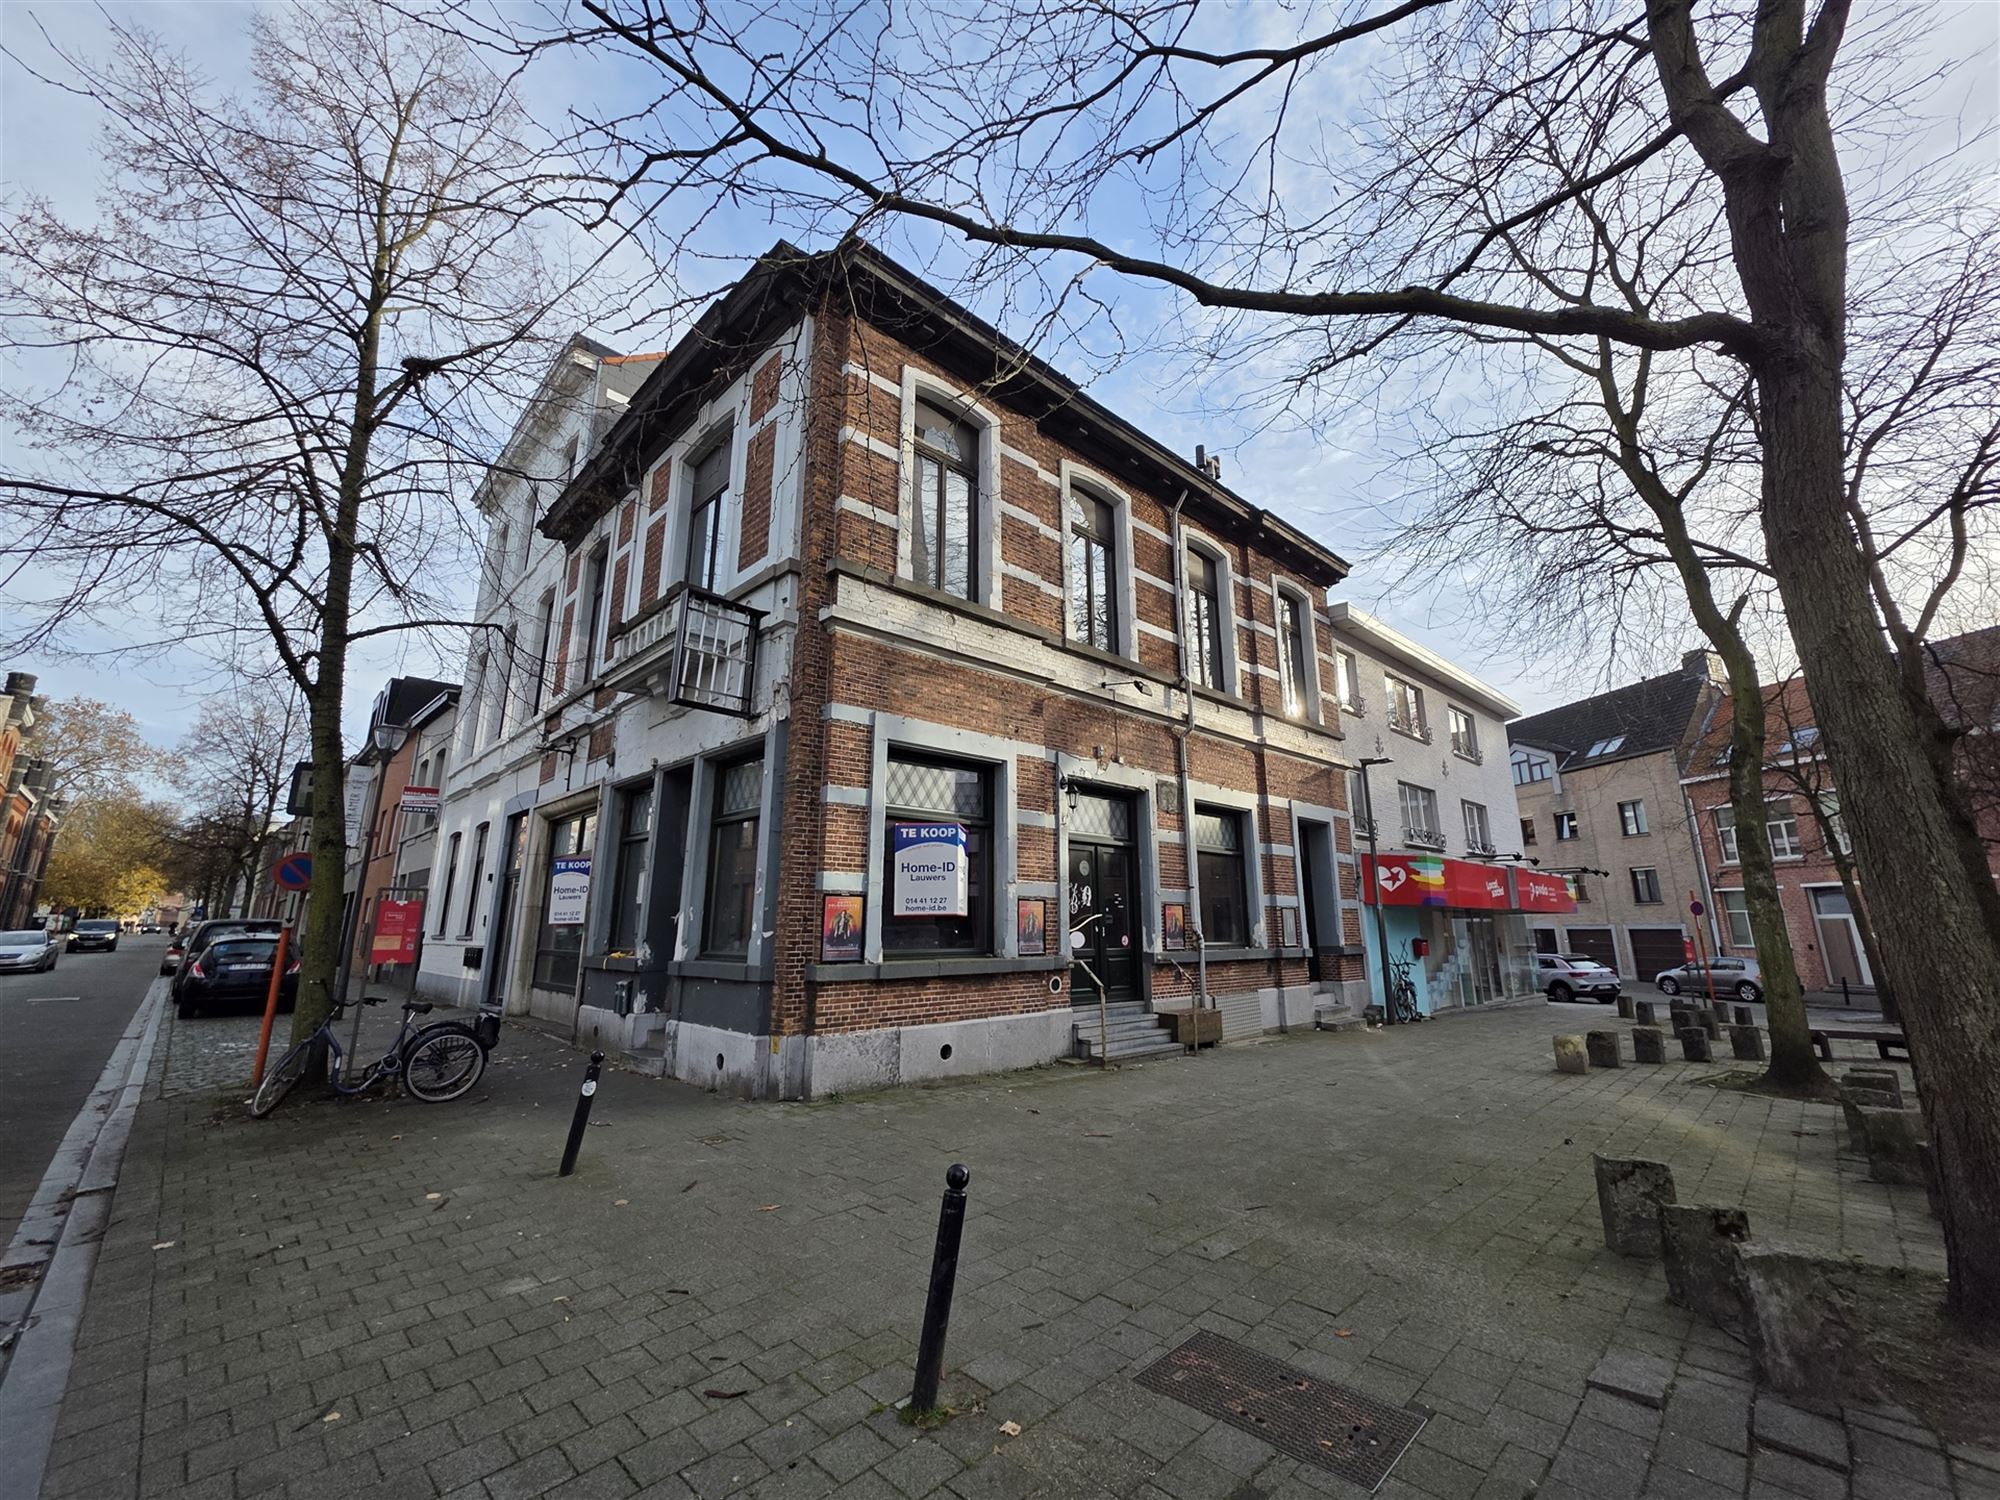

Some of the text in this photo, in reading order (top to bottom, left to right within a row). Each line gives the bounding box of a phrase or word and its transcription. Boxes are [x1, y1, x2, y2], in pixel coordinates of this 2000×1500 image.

[901, 828, 916, 838] TE
[921, 827, 956, 838] KOOP
[568, 861, 592, 869] KOOP
[901, 862, 955, 872] Home-ID
[554, 886, 588, 894] Home-ID
